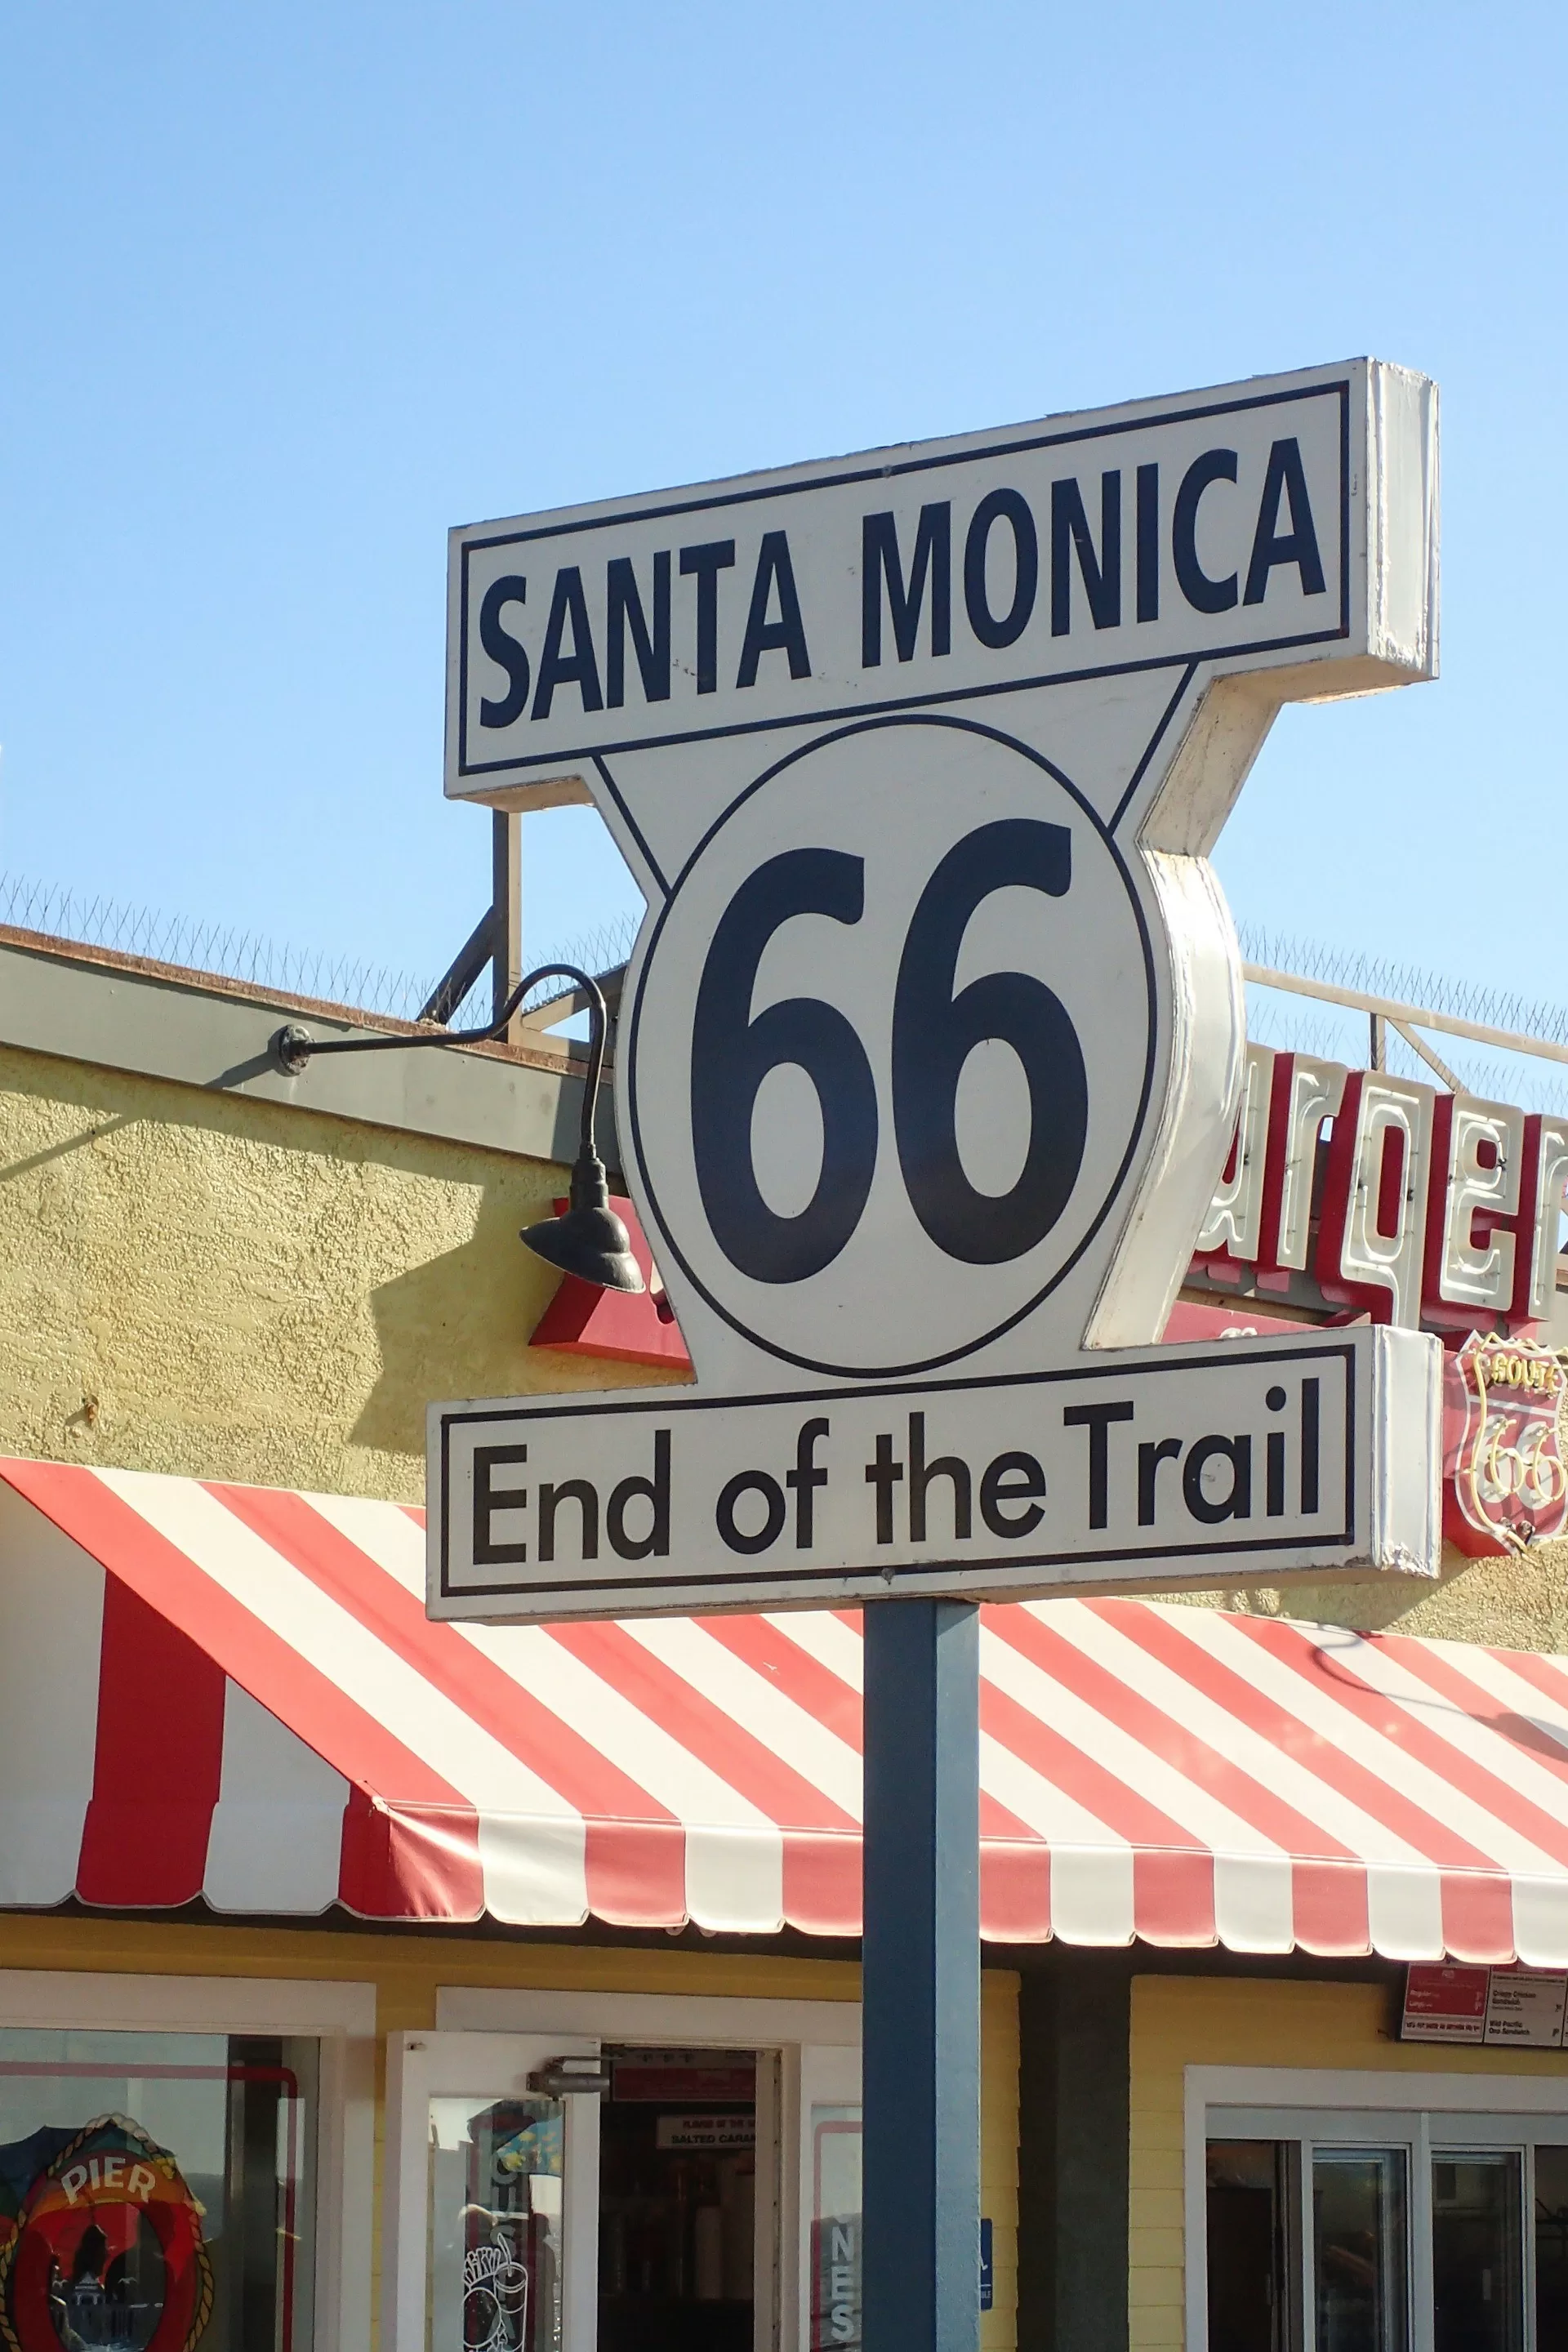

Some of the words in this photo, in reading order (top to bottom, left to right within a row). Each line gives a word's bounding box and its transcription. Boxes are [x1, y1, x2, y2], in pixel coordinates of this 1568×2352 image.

[479, 529, 812, 729] SANTA
[862, 437, 1327, 670] MONICA
[691, 818, 1088, 1285] 66
[1480, 1352, 1561, 1399] ROUTE
[473, 1429, 671, 1566] End
[715, 1417, 830, 1555] of
[864, 1411, 1047, 1544] the
[1062, 1378, 1320, 1531] Trail
[1474, 1414, 1566, 1510] 66
[61, 2155, 156, 2205] PIER
[831, 2213, 856, 2341] NES
